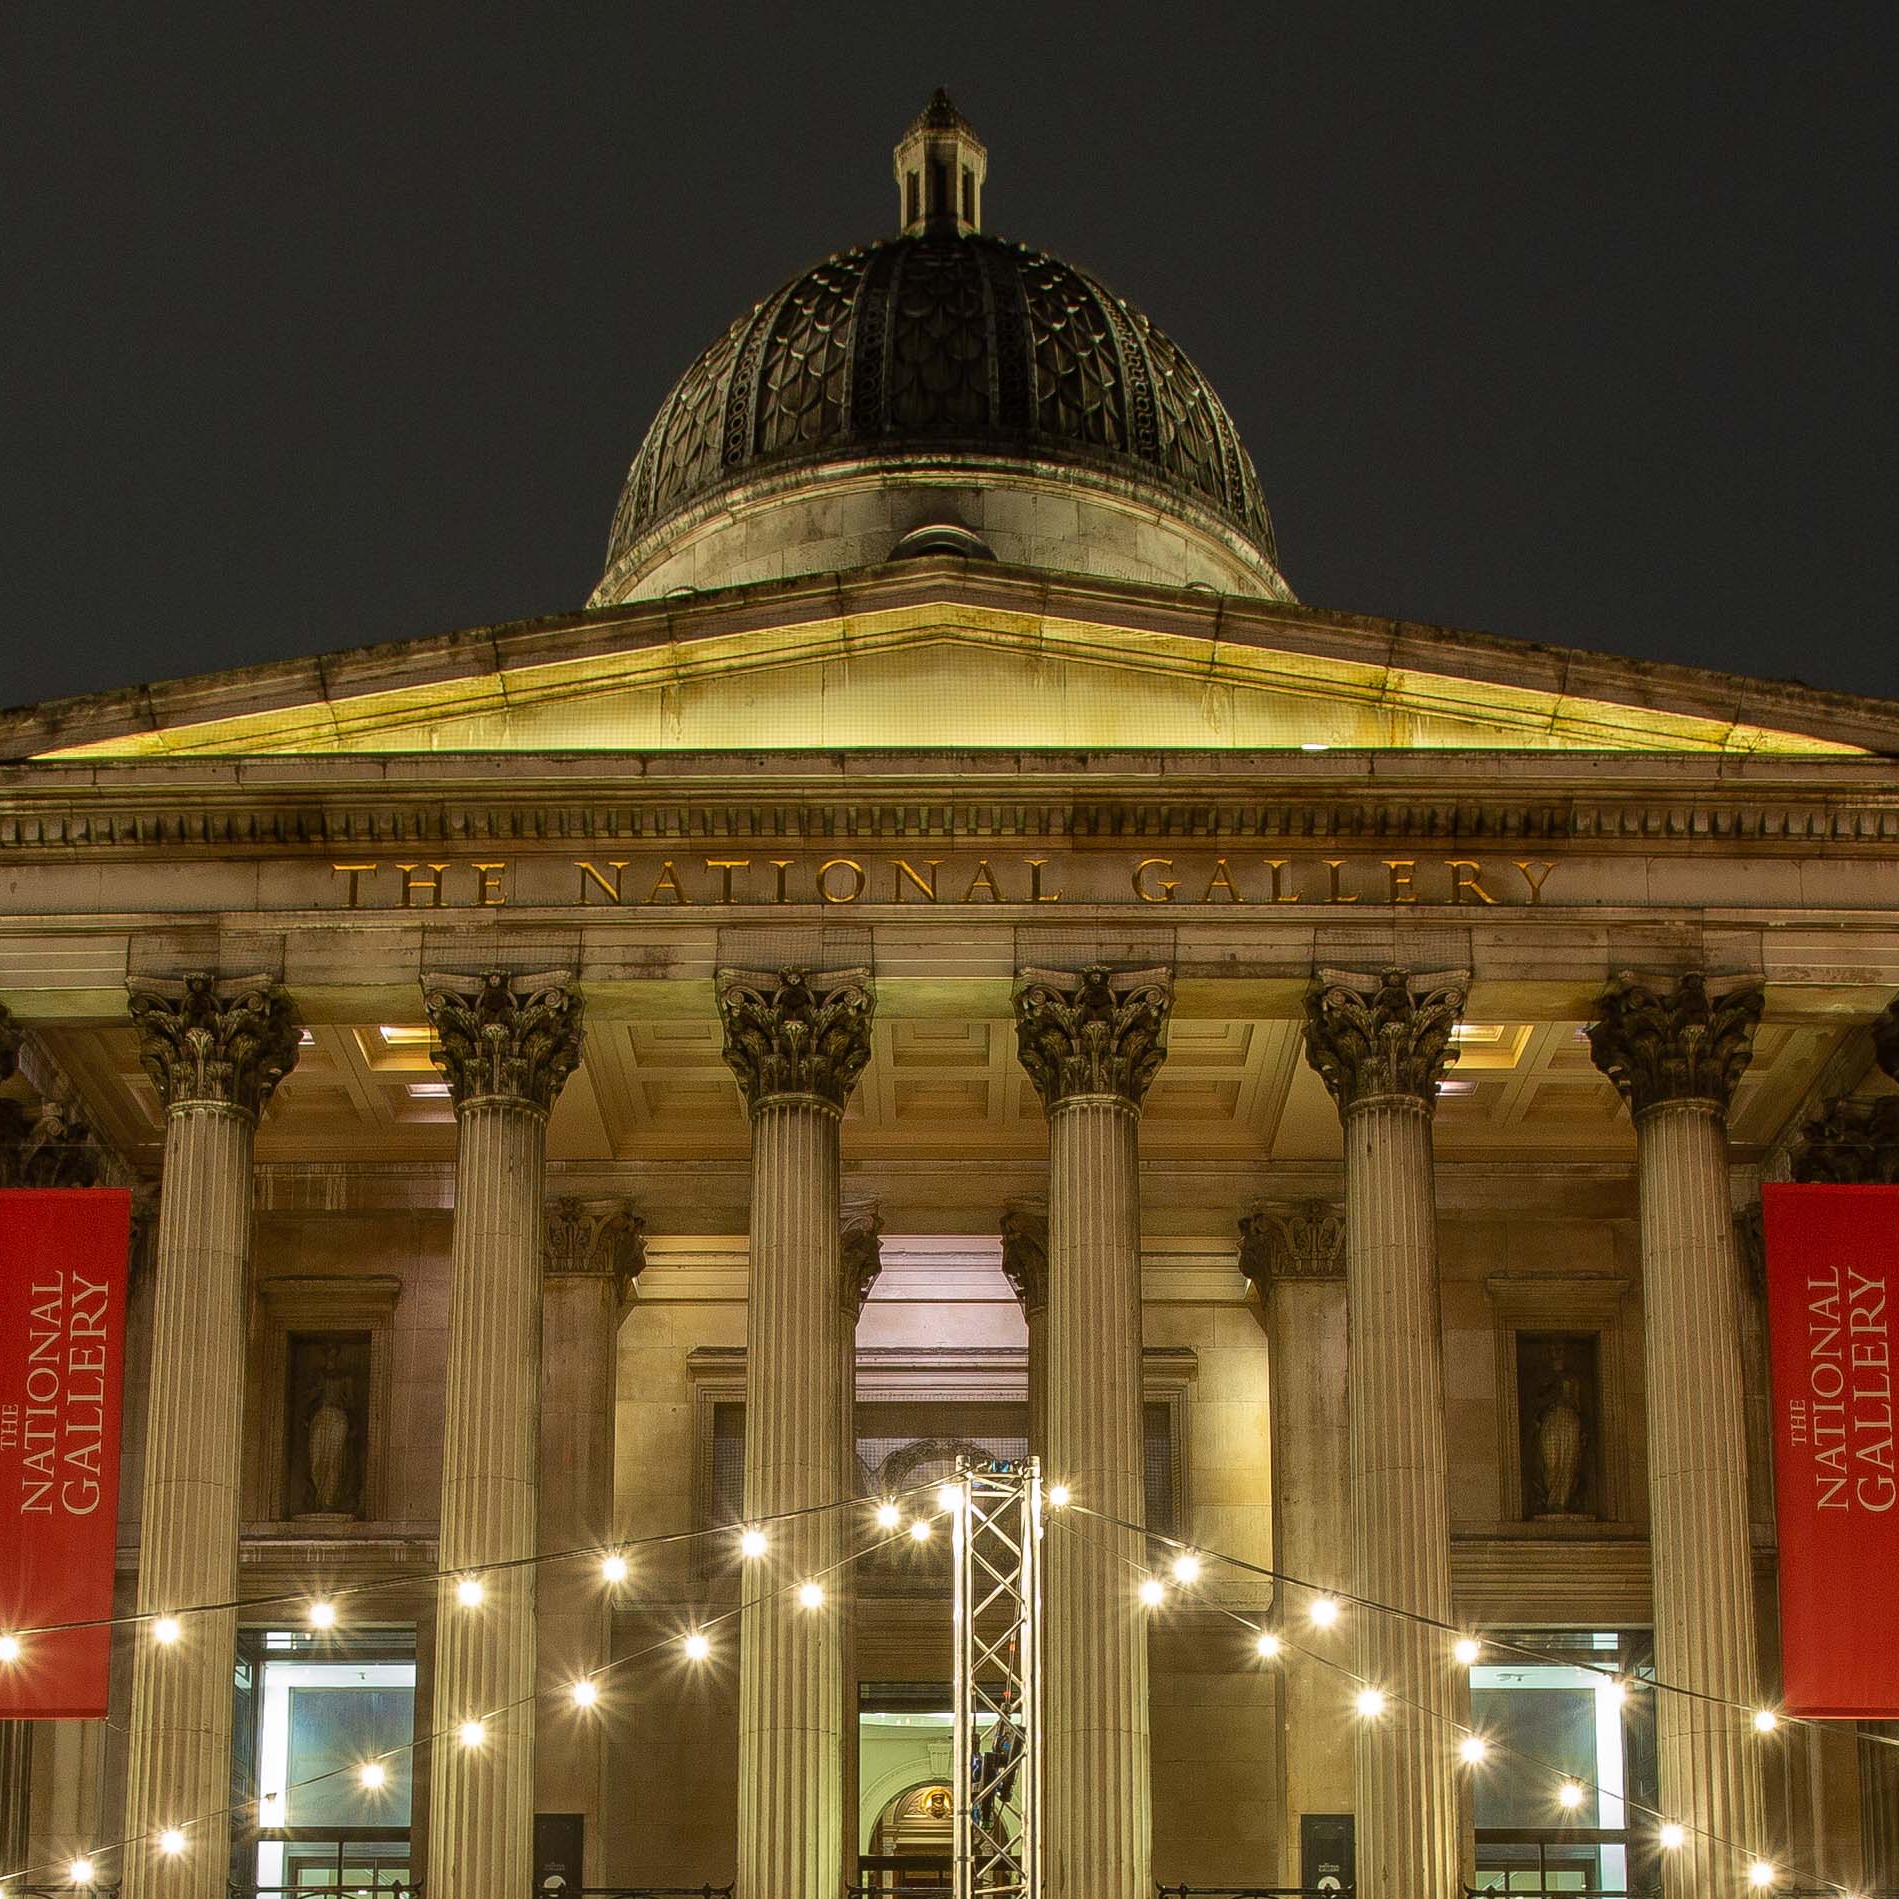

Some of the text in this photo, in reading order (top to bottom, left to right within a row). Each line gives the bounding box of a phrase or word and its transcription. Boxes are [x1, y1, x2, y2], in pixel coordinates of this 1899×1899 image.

[331, 858, 1559, 907] THE NATIONAL GALLERY
[1, 1403, 19, 1450] THE
[21, 1270, 65, 1515] NATIONAL
[61, 1272, 109, 1516] GALLERY
[1789, 1400, 1807, 1446] THE
[1807, 1265, 1849, 1512] NATIONAL
[1848, 1267, 1897, 1512] GALLERY
